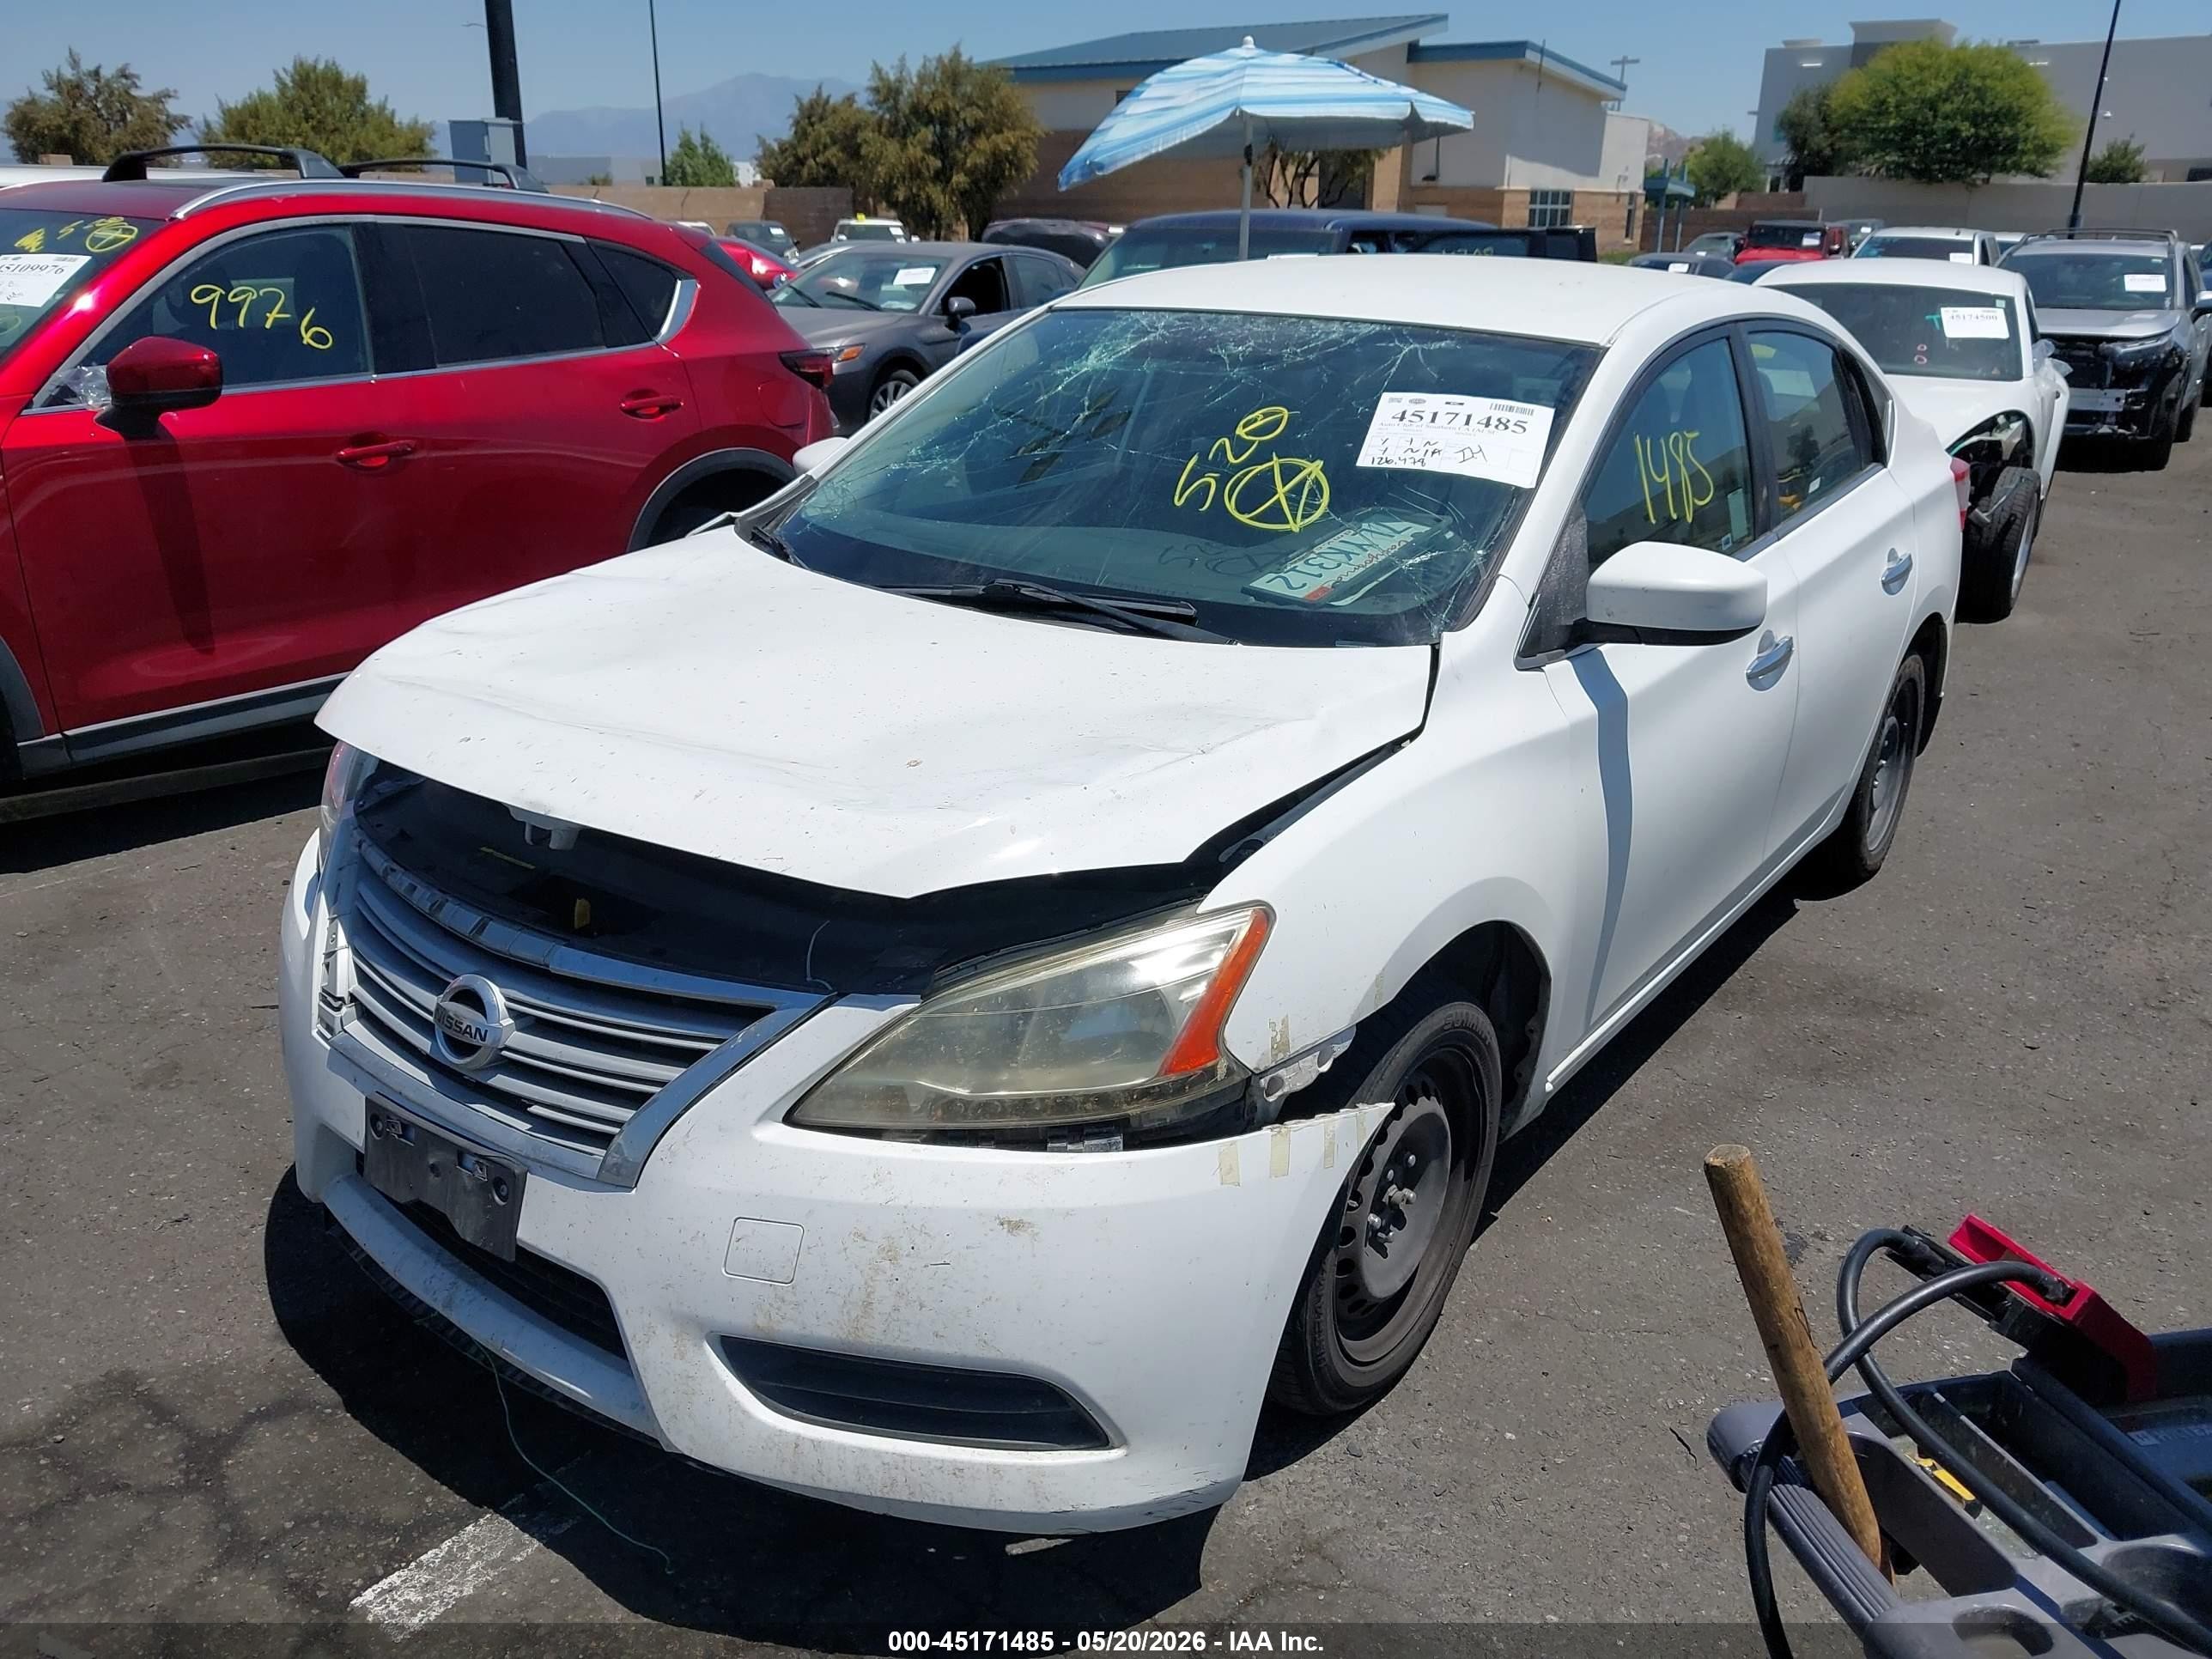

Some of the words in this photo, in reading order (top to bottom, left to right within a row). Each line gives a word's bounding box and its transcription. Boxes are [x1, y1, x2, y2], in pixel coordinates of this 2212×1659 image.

[191, 284, 333, 349] 9976
[1391, 409, 1528, 435] 45171485
[1633, 431, 1715, 525] 1485
[434, 1000, 489, 1042] NISSAN
